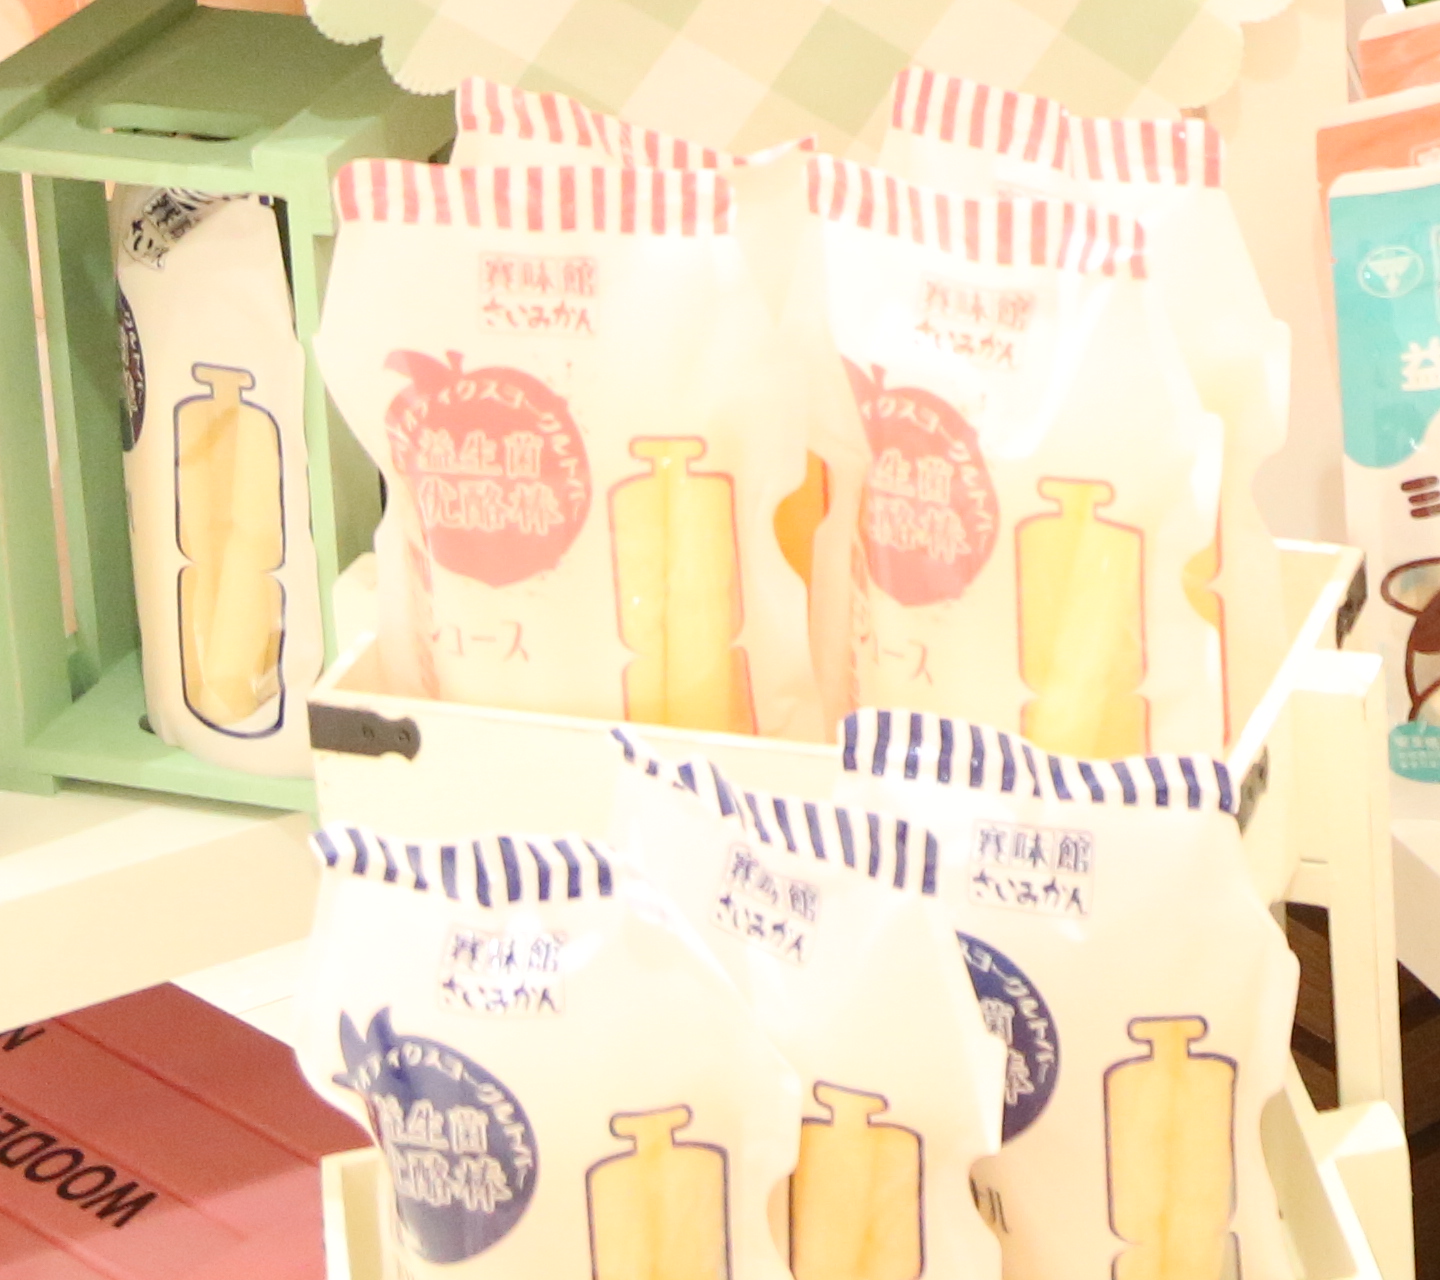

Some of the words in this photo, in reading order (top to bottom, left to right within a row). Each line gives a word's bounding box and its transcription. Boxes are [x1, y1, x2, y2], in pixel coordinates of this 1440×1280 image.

[415, 430, 545, 480] 益生菌
[418, 478, 564, 537] 优酪棒
